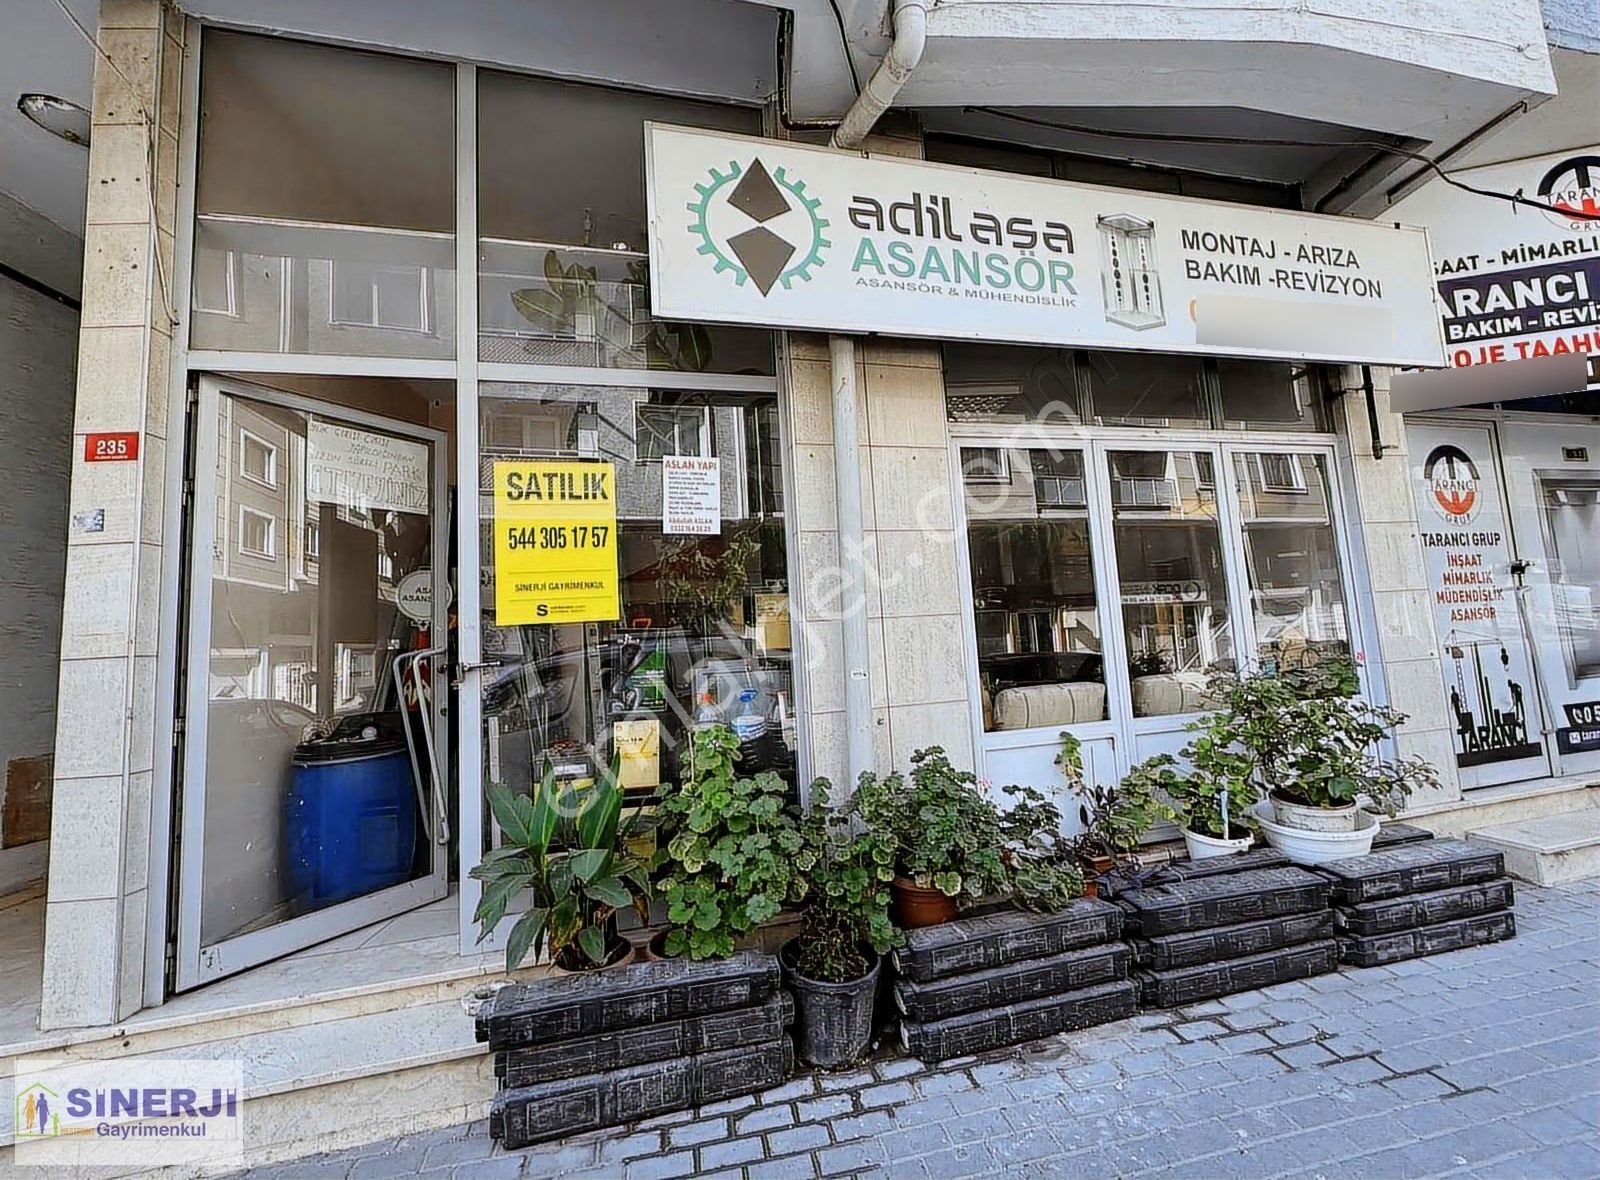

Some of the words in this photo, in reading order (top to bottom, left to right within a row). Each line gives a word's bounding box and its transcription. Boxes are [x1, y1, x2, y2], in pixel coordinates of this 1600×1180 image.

[1180, 228, 1277, 260] MONTAJ
[1296, 243, 1360, 270] ARIZA
[850, 236, 1079, 297] ASANSÖR
[1184, 258, 1262, 287] BAKIM
[855, 274, 943, 298] ASANSÖR
[947, 286, 961, 297] &
[964, 288, 1078, 309] MÜHENDİSLİK
[1448, 314, 1522, 340] BAKIM
[96, 439, 128, 456] 235
[382, 460, 424, 483] PARK
[665, 460, 695, 470] ASLAN
[697, 461, 717, 471] YAPI
[506, 471, 609, 502] SATILIK
[508, 526, 537, 551] 544
[540, 526, 568, 550] 305
[571, 526, 588, 549] 17
[591, 526, 609, 549] 57
[1421, 532, 1471, 548] TARANCI
[1472, 532, 1501, 547] GRUP
[1446, 551, 1483, 568] İNŞAAT
[1443, 569, 1494, 586] MİMARLIK
[1451, 604, 1497, 622] ASANSÖR
